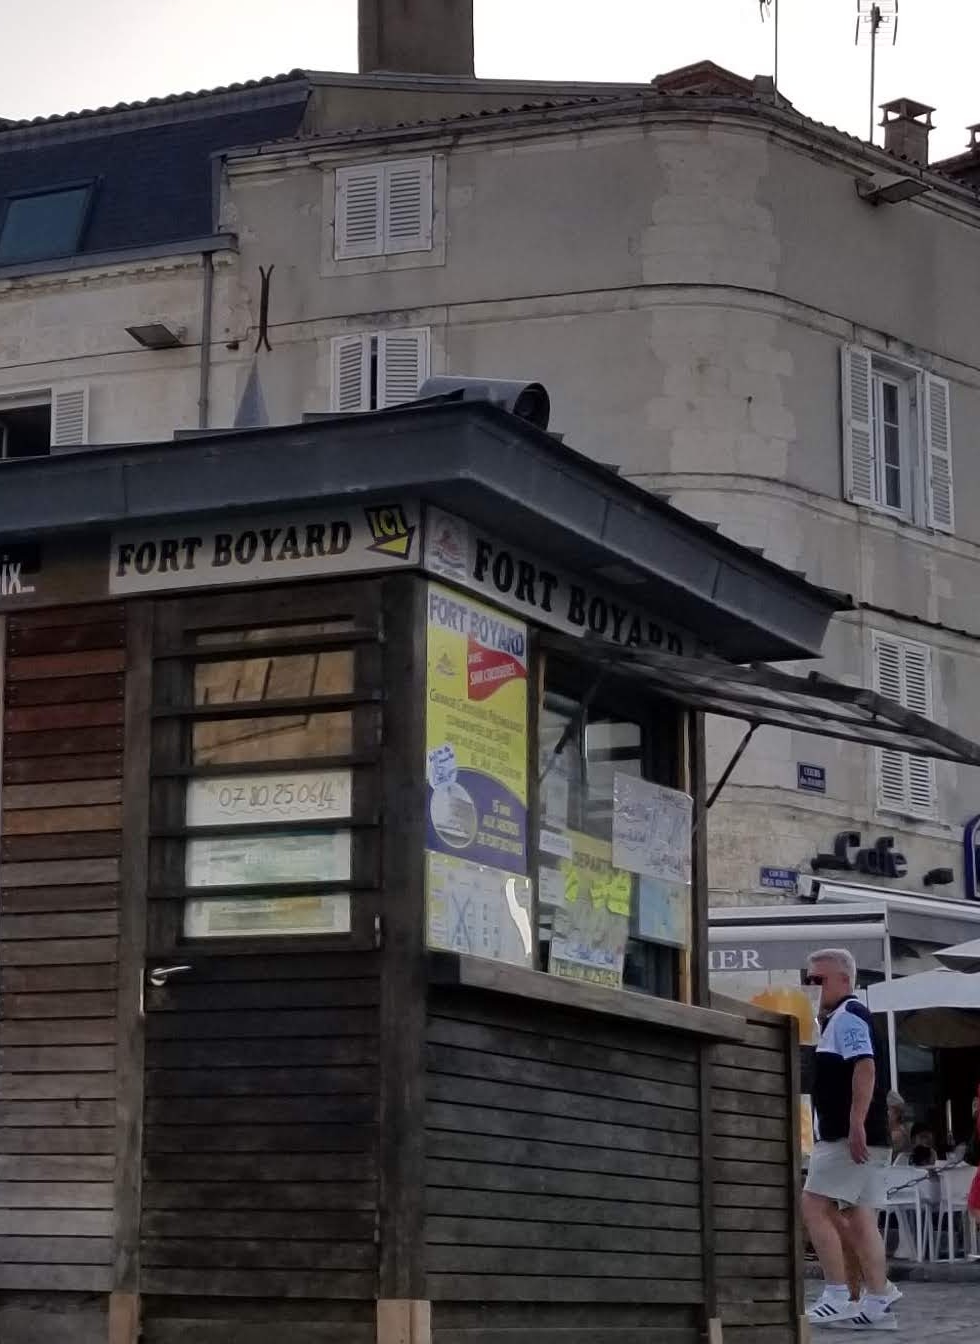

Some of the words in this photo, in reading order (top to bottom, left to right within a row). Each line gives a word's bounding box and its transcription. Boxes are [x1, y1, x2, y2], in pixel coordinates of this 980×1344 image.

[115, 536, 203, 577] FORT
[211, 521, 352, 568] BOYARD
[472, 538, 558, 613] FORT
[429, 593, 468, 633] FORT
[470, 611, 525, 657] BOYARD
